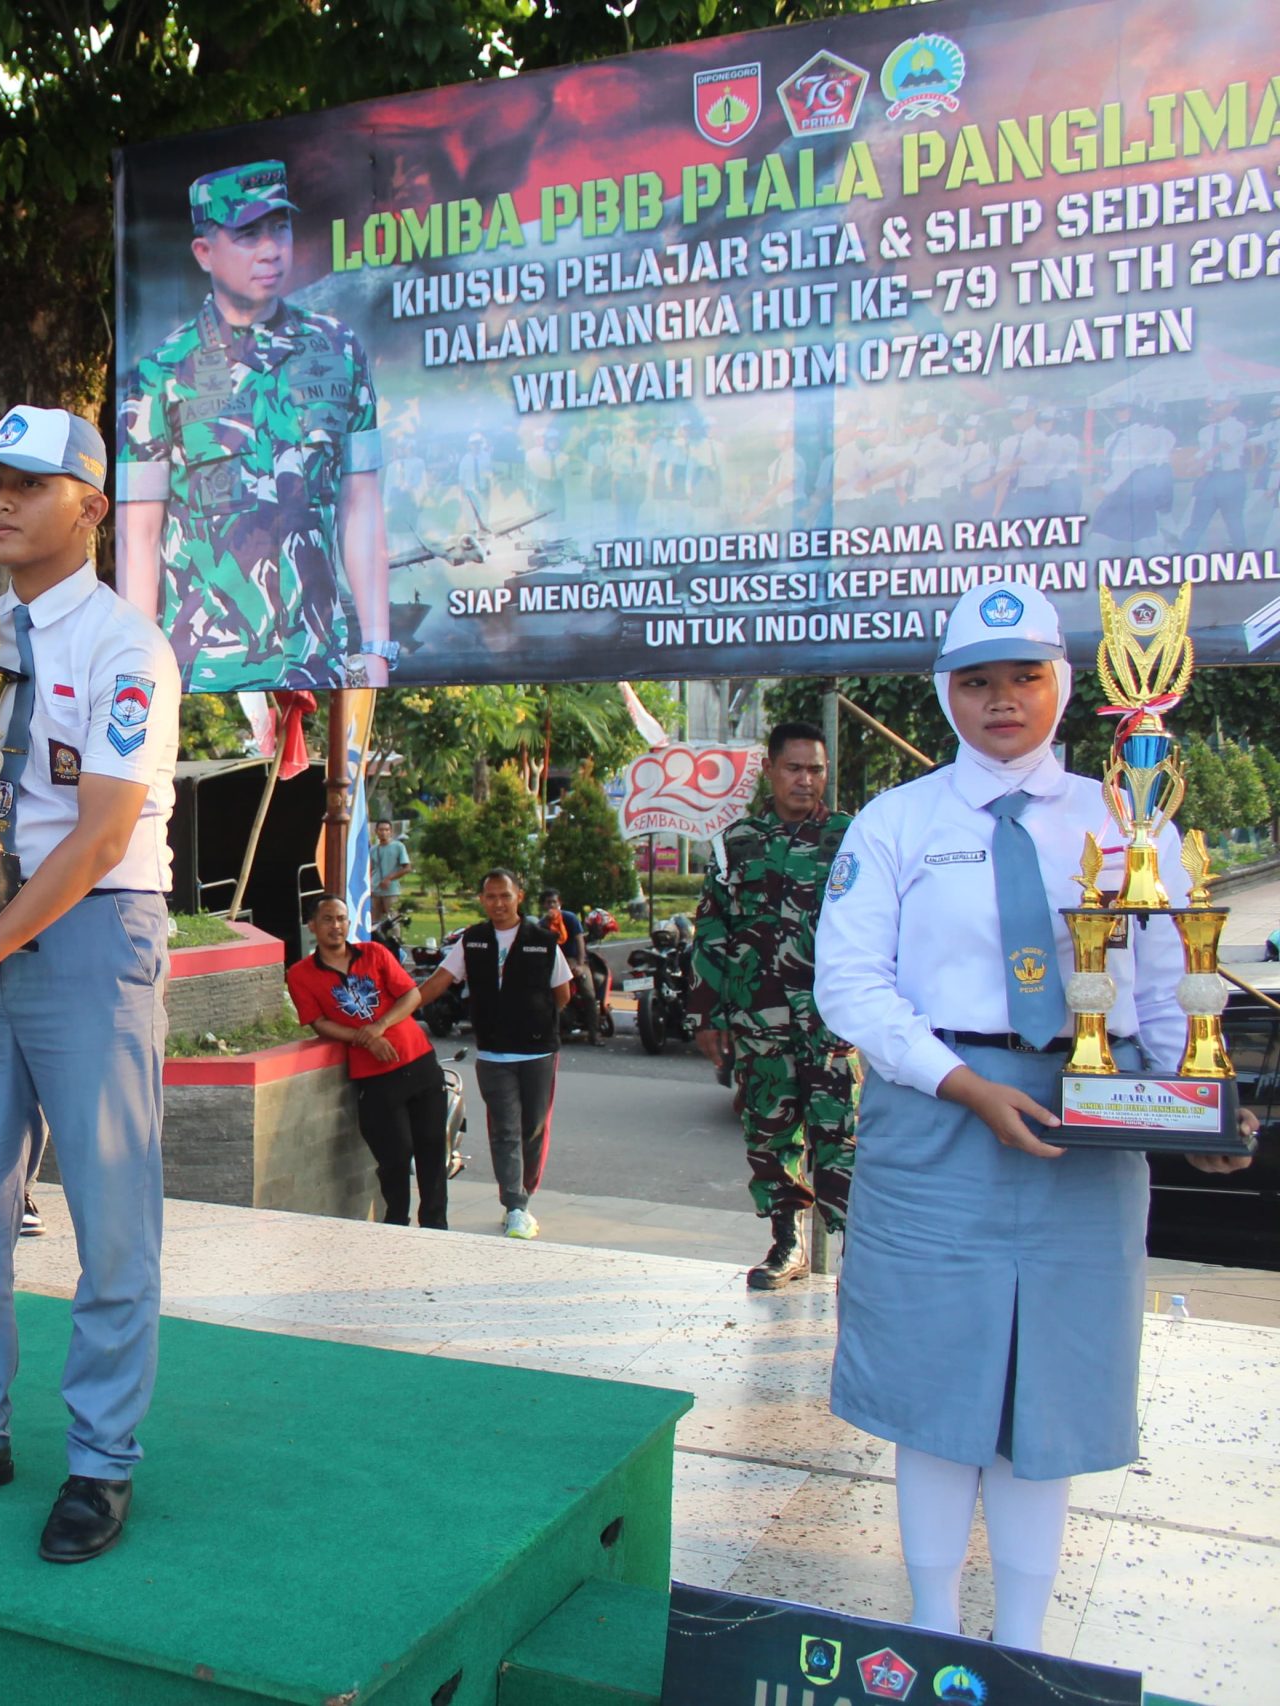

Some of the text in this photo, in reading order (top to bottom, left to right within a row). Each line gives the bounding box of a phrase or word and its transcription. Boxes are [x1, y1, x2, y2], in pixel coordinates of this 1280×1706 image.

[696, 66, 758, 85] DIPONEGORO
[801, 114, 846, 130] PRIMA
[331, 75, 1280, 272] LOMBA PBB PIALA PANGLIMA
[392, 261, 546, 319] KHUSUS
[558, 235, 748, 299] PELAJAR
[760, 222, 866, 273] SLTA
[879, 215, 912, 260] &
[925, 199, 1043, 255] SLTP
[424, 314, 558, 367] DALAM
[570, 294, 740, 351] RANGKA
[752, 282, 838, 332] HUT
[850, 265, 997, 321] KE-79
[1010, 253, 1095, 304] TNI
[1108, 242, 1175, 293] TH
[512, 306, 1193, 413] WILAYAH KODIM 0723/KLATEN
[595, 515, 1087, 569] TNI MODERN BERSAMA RAKYAT
[448, 550, 1280, 616] SIAP MENGAWAL SUKSESI KEPEMIMPINAN NASIONAL
[646, 616, 747, 648] UNTUK
[755, 610, 925, 642] INDONESIA
[626, 748, 737, 814] 220
[633, 750, 760, 836] SEMBADA NATA PRAJA
[1110, 1093, 1152, 1103] JUARA
[871, 1664, 904, 1692] 79
